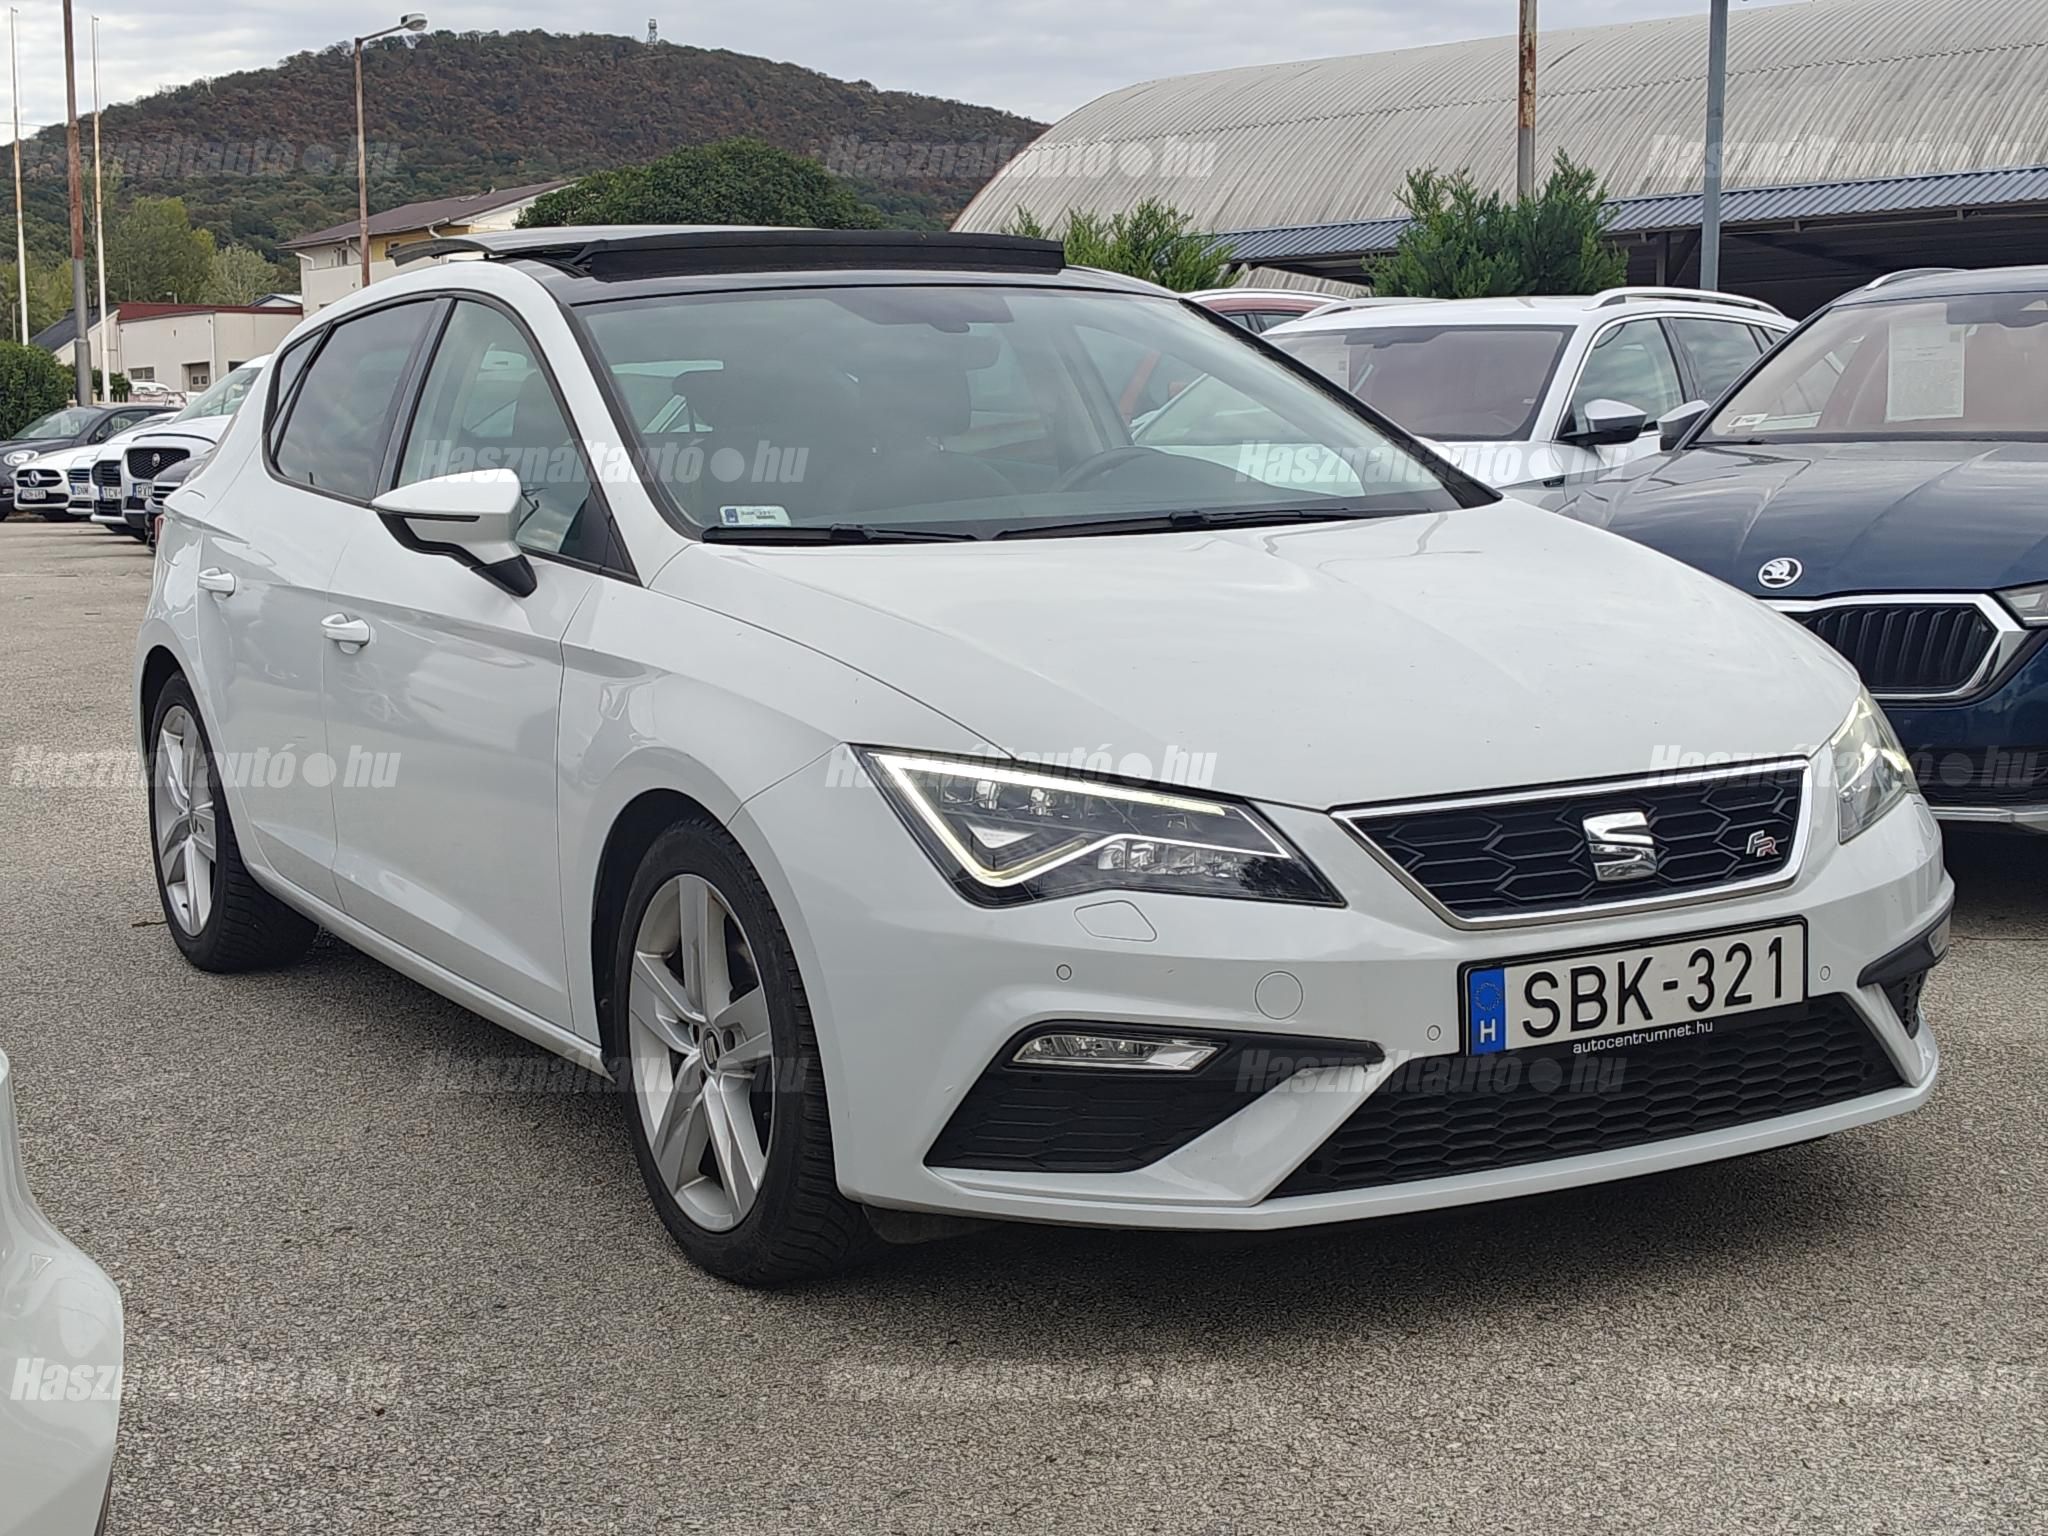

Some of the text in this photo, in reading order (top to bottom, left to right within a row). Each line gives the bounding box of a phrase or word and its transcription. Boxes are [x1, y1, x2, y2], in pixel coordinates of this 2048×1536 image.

[1745, 829, 1779, 857] FR
[1521, 936, 1783, 1039] SBK-321
[1478, 1019, 1497, 1044] H
[1572, 1020, 1714, 1054] autocentrumnet.hu
